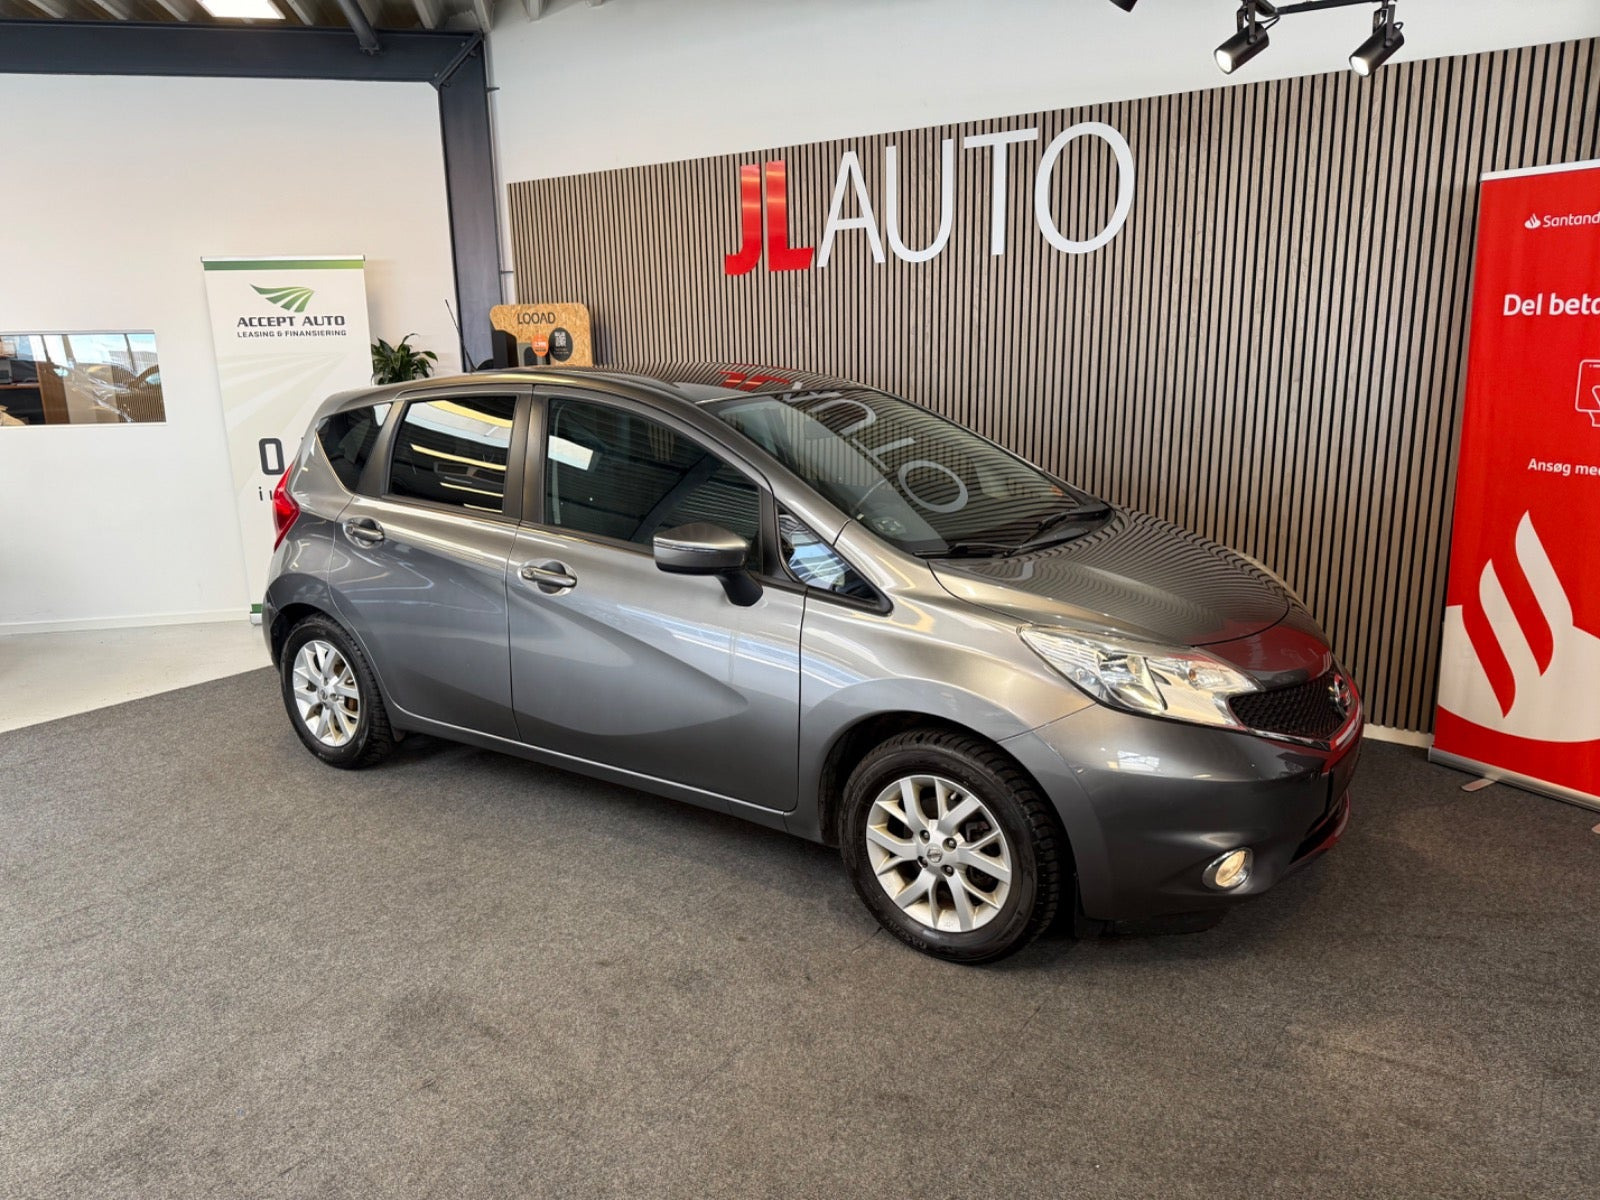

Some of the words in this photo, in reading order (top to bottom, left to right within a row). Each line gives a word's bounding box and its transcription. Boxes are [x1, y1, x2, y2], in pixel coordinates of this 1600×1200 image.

[1503, 292, 1543, 316] Del
[237, 316, 296, 328] ACCEPT
[302, 315, 346, 326] AUTO
[517, 312, 556, 325] LOOAD
[285, 329, 347, 337] FINANSIERING
[1527, 458, 1572, 477] Ansøg
[1575, 465, 1600, 476] me
